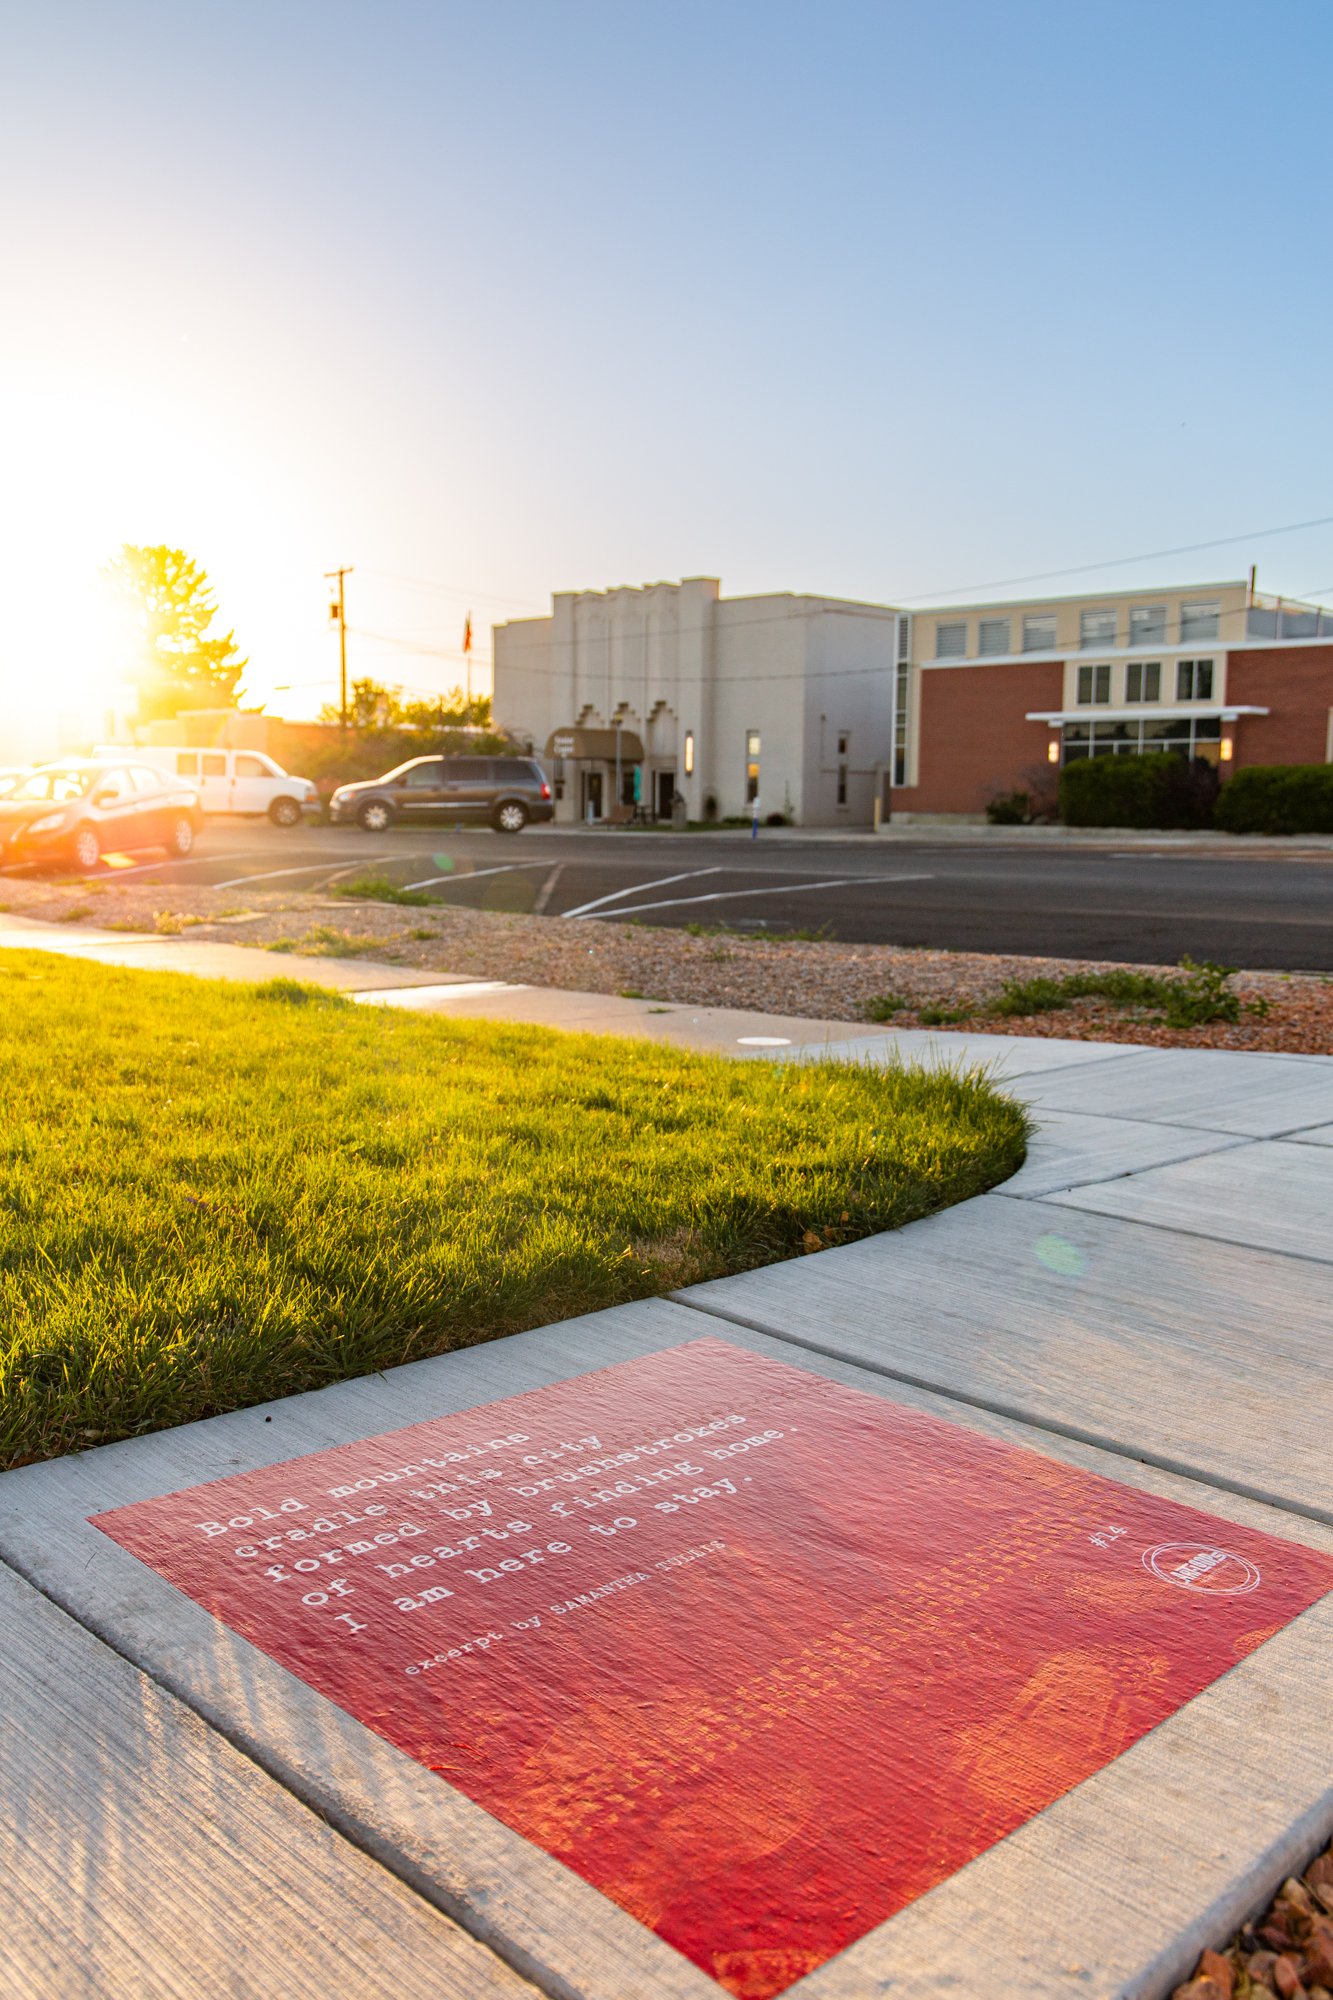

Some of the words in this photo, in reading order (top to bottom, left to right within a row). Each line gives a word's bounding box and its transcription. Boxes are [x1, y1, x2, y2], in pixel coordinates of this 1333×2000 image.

[195, 1498, 309, 1537] Bold
[326, 1433, 530, 1499] mountains
[235, 1503, 388, 1557] cradle
[409, 1468, 503, 1500] this
[523, 1435, 602, 1465] city
[264, 1522, 427, 1582] formed
[439, 1500, 493, 1521] by
[507, 1413, 746, 1497] brushstrokes
[302, 1578, 355, 1606] of
[375, 1520, 532, 1578] hearts
[550, 1460, 704, 1517] finding
[703, 1427, 798, 1460] home.
[1087, 1525, 1128, 1549] #14
[335, 1612, 368, 1634] I
[393, 1586, 455, 1611] am
[464, 1541, 572, 1584] here
[589, 1517, 638, 1536] to
[654, 1476, 753, 1513] stay.
[405, 1631, 503, 1675] excerpt
[511, 1615, 542, 1631] by
[549, 1571, 653, 1615] SAMANTHA
[655, 1540, 726, 1572] TULLIS
